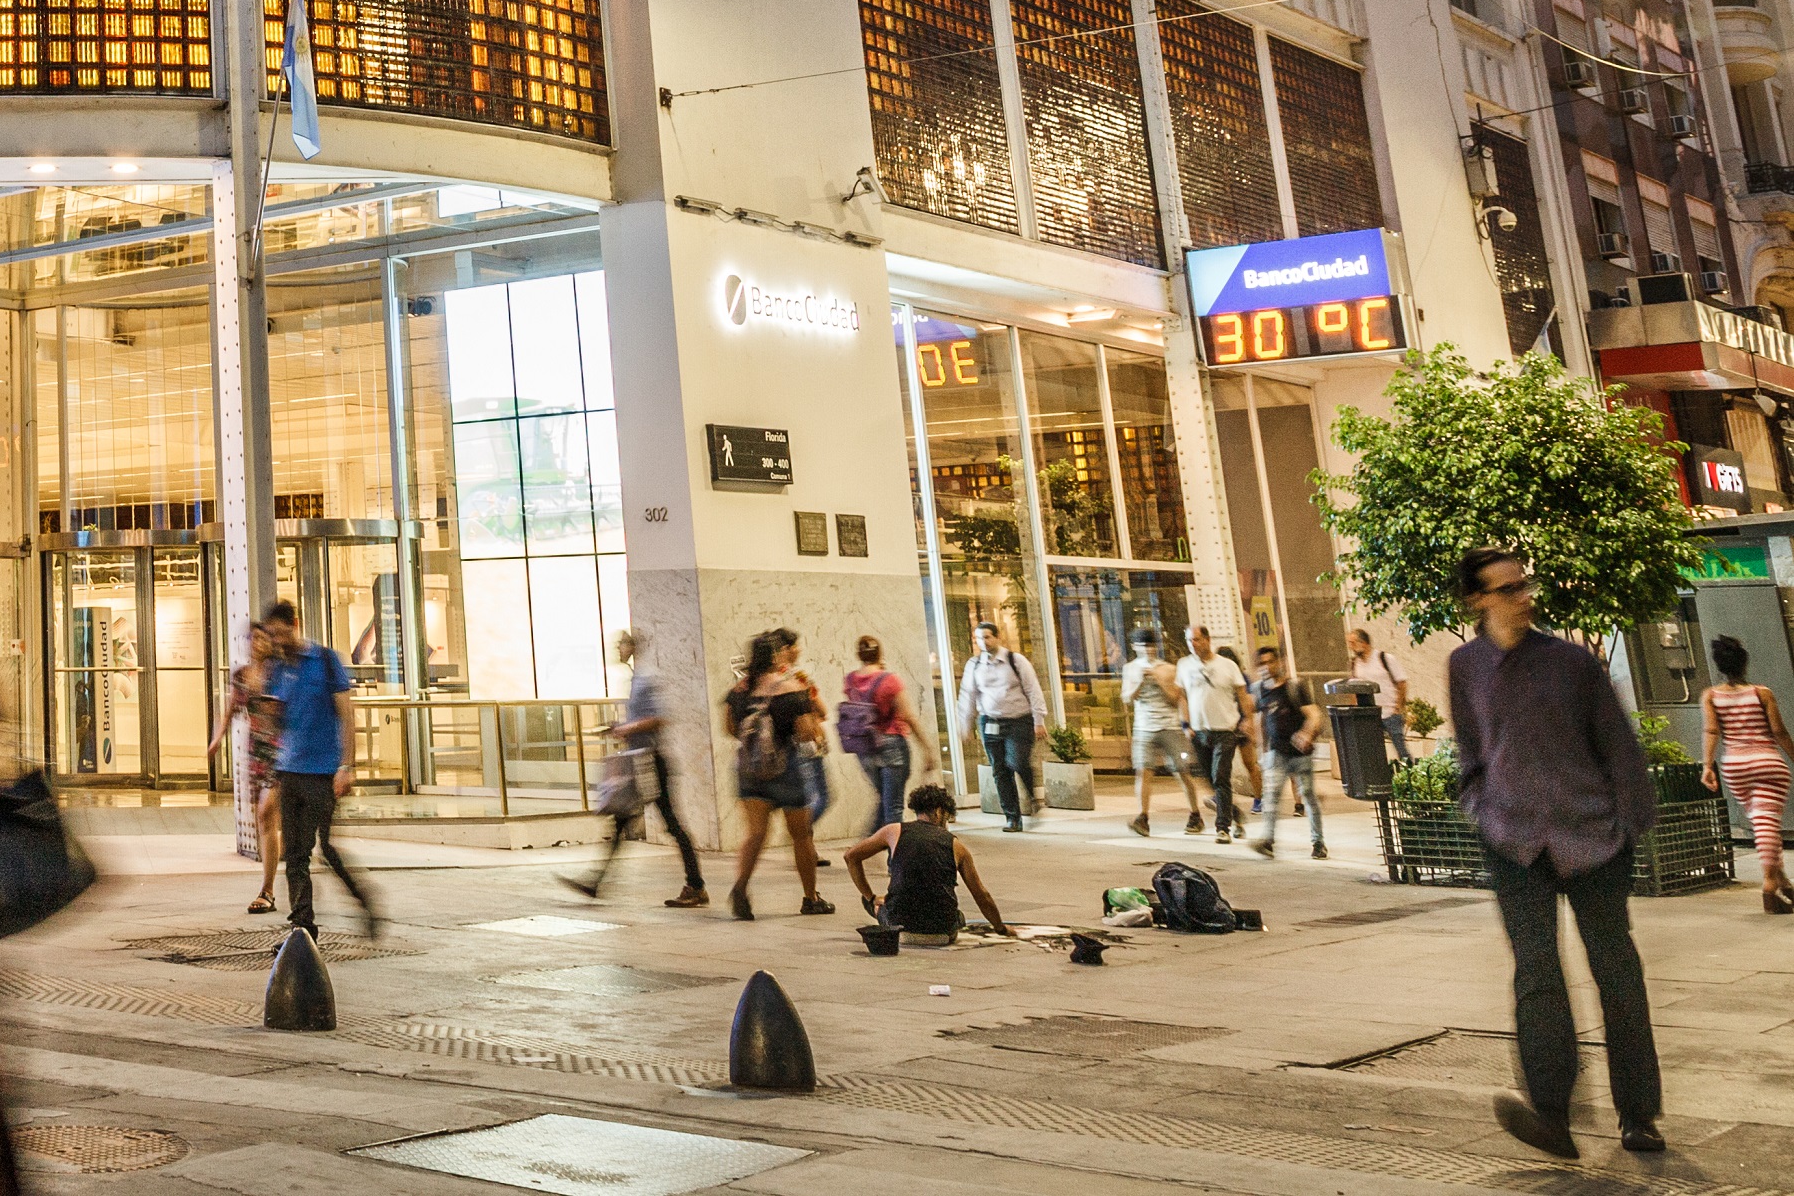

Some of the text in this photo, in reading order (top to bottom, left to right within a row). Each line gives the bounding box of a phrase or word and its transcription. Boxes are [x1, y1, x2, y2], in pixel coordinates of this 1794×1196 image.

[1243, 255, 1369, 289] BancoCiudad
[751, 286, 860, 332] BancoCiudad
[1216, 310, 1285, 364] 30
[765, 431, 787, 443] Florida
[762, 457, 774, 469] 300
[778, 459, 789, 469] 400
[645, 507, 668, 522] 302
